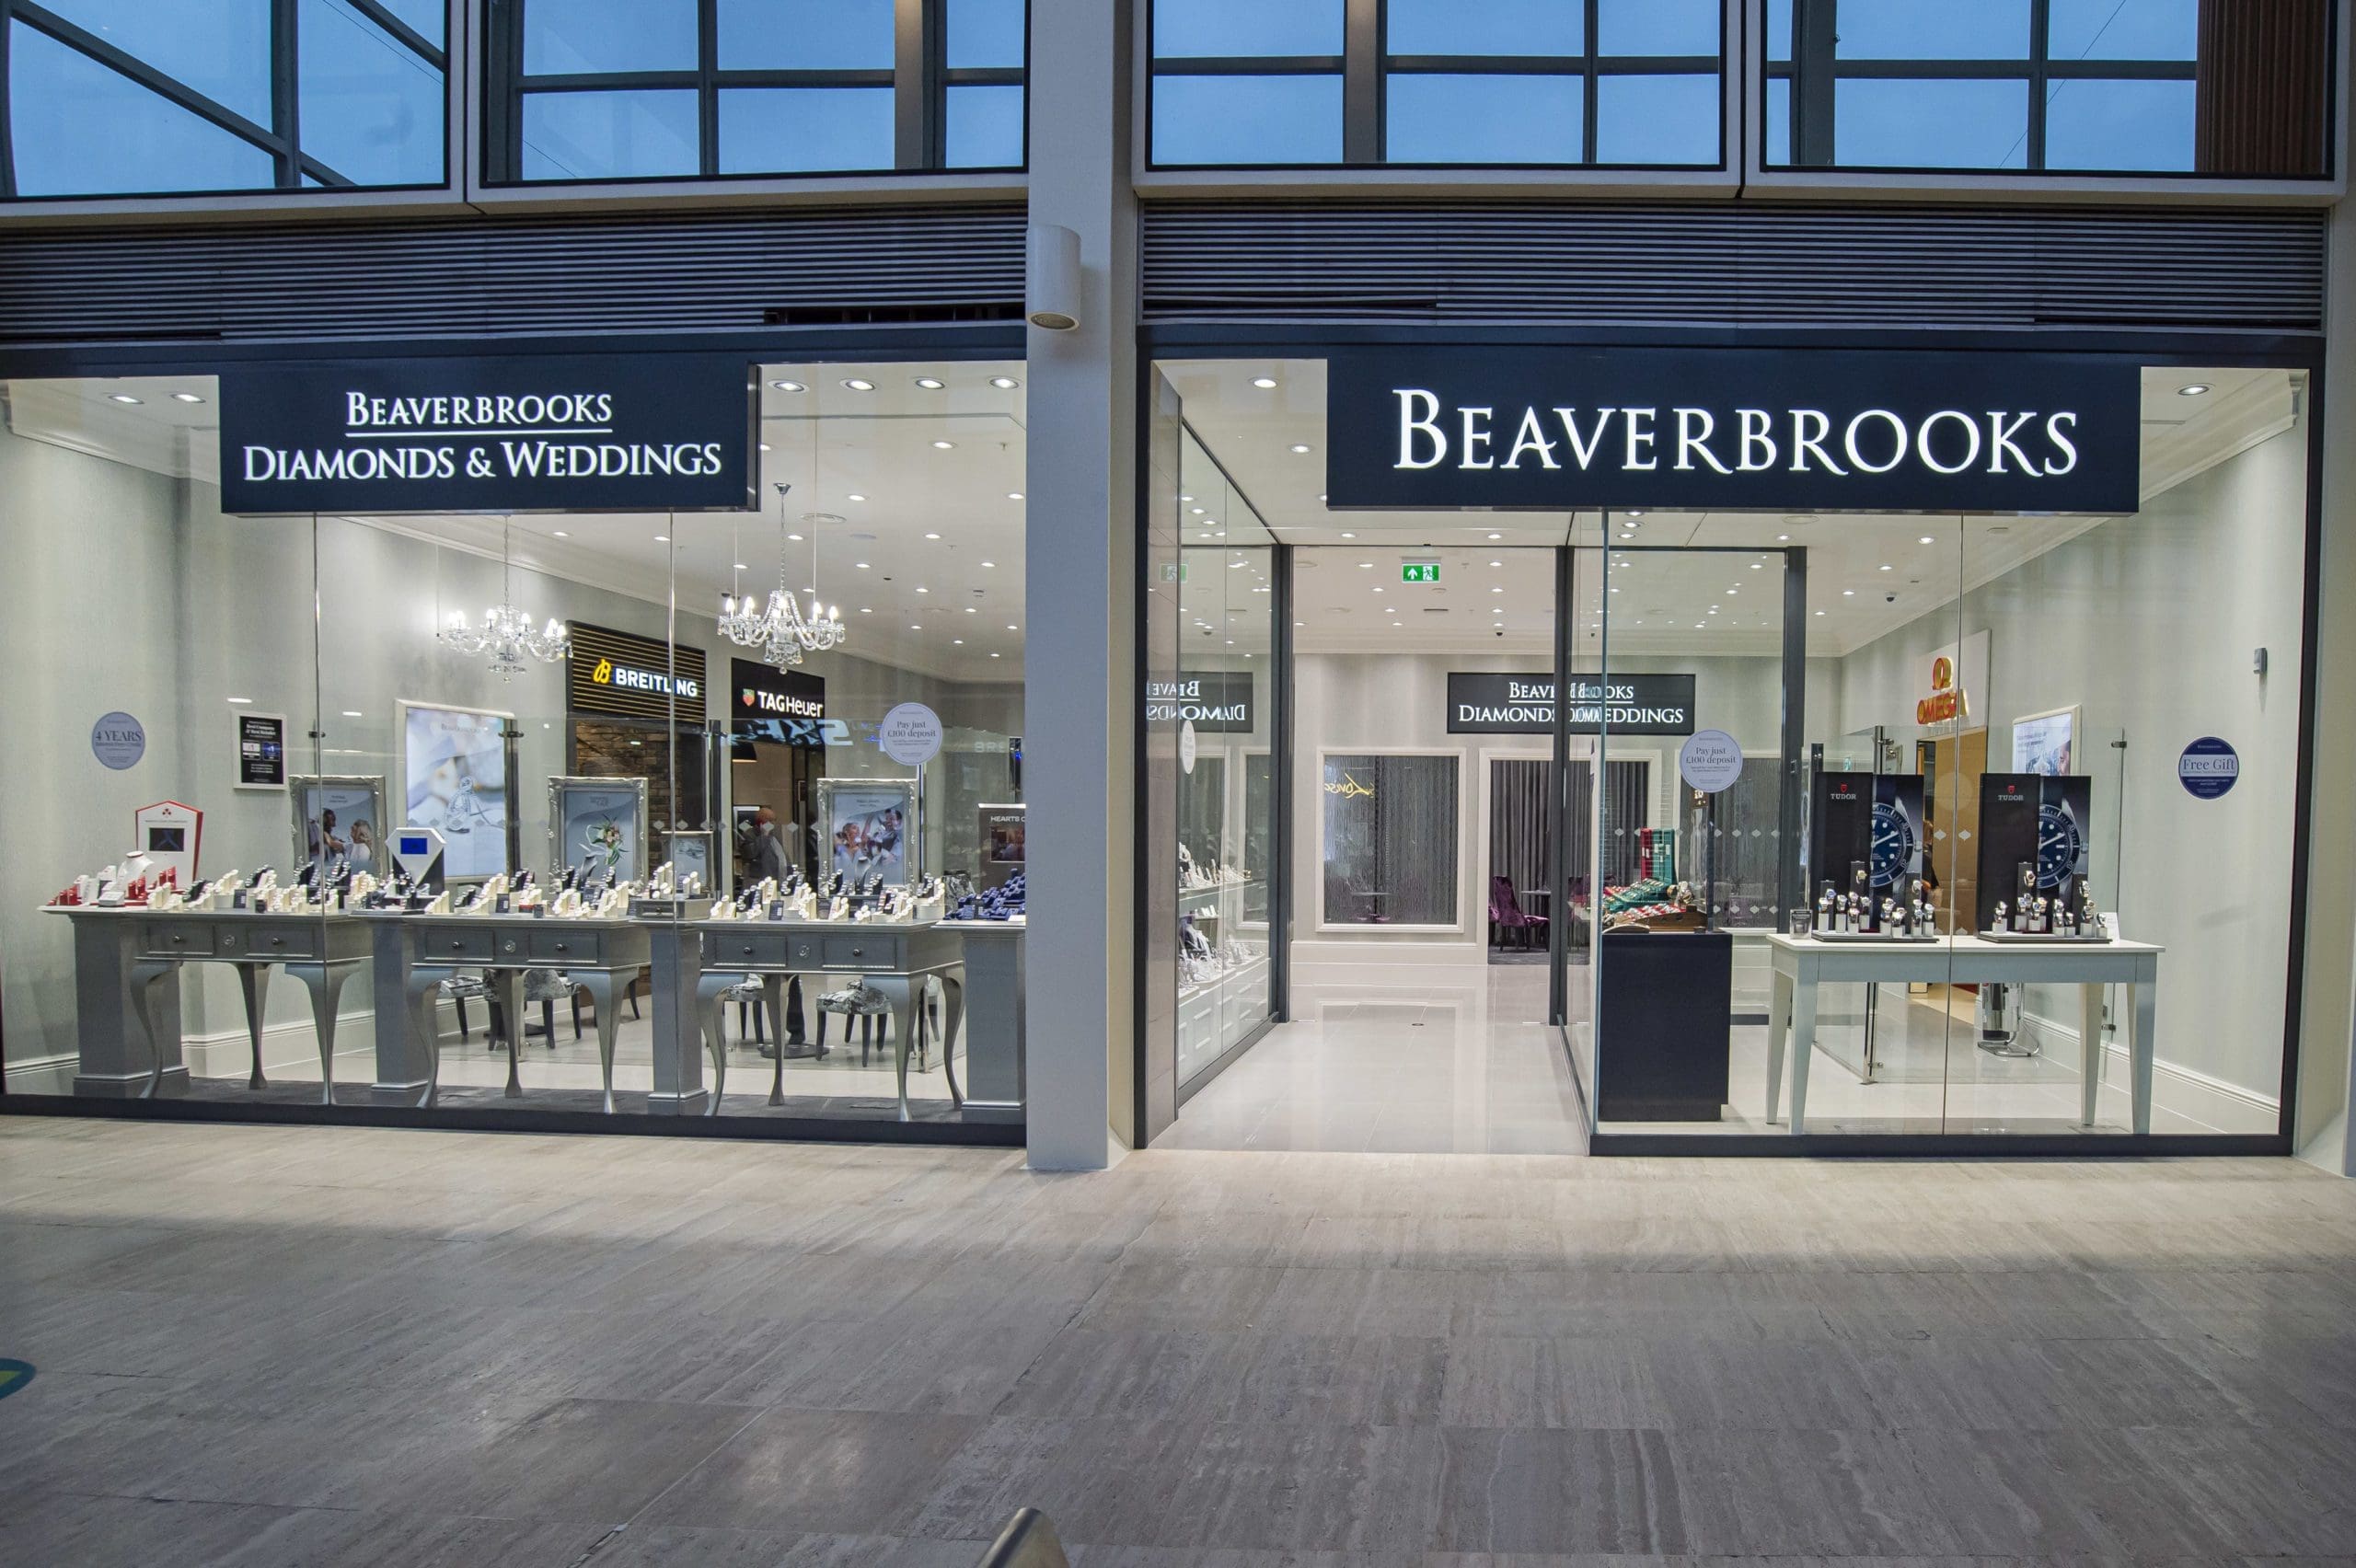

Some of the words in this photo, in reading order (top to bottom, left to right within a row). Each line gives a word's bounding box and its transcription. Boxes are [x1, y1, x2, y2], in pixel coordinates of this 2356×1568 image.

[345, 391, 613, 426] BEAVERBROOKS
[1392, 388, 2077, 477] BEAVERBROOKS
[243, 445, 456, 481] DIAMONDS
[466, 447, 497, 478] &
[500, 441, 722, 478] WEDDINGS
[615, 667, 698, 698] BREITLNG
[896, 721, 911, 730] Pay
[912, 720, 926, 730] just
[104, 730, 142, 742] YEARS
[907, 729, 936, 738] deposit
[1695, 746, 1711, 755] Pay
[1711, 746, 1727, 756] just
[1706, 755, 1737, 765] deposit
[2183, 758, 2210, 770] Free
[2212, 758, 2235, 770] Gift
